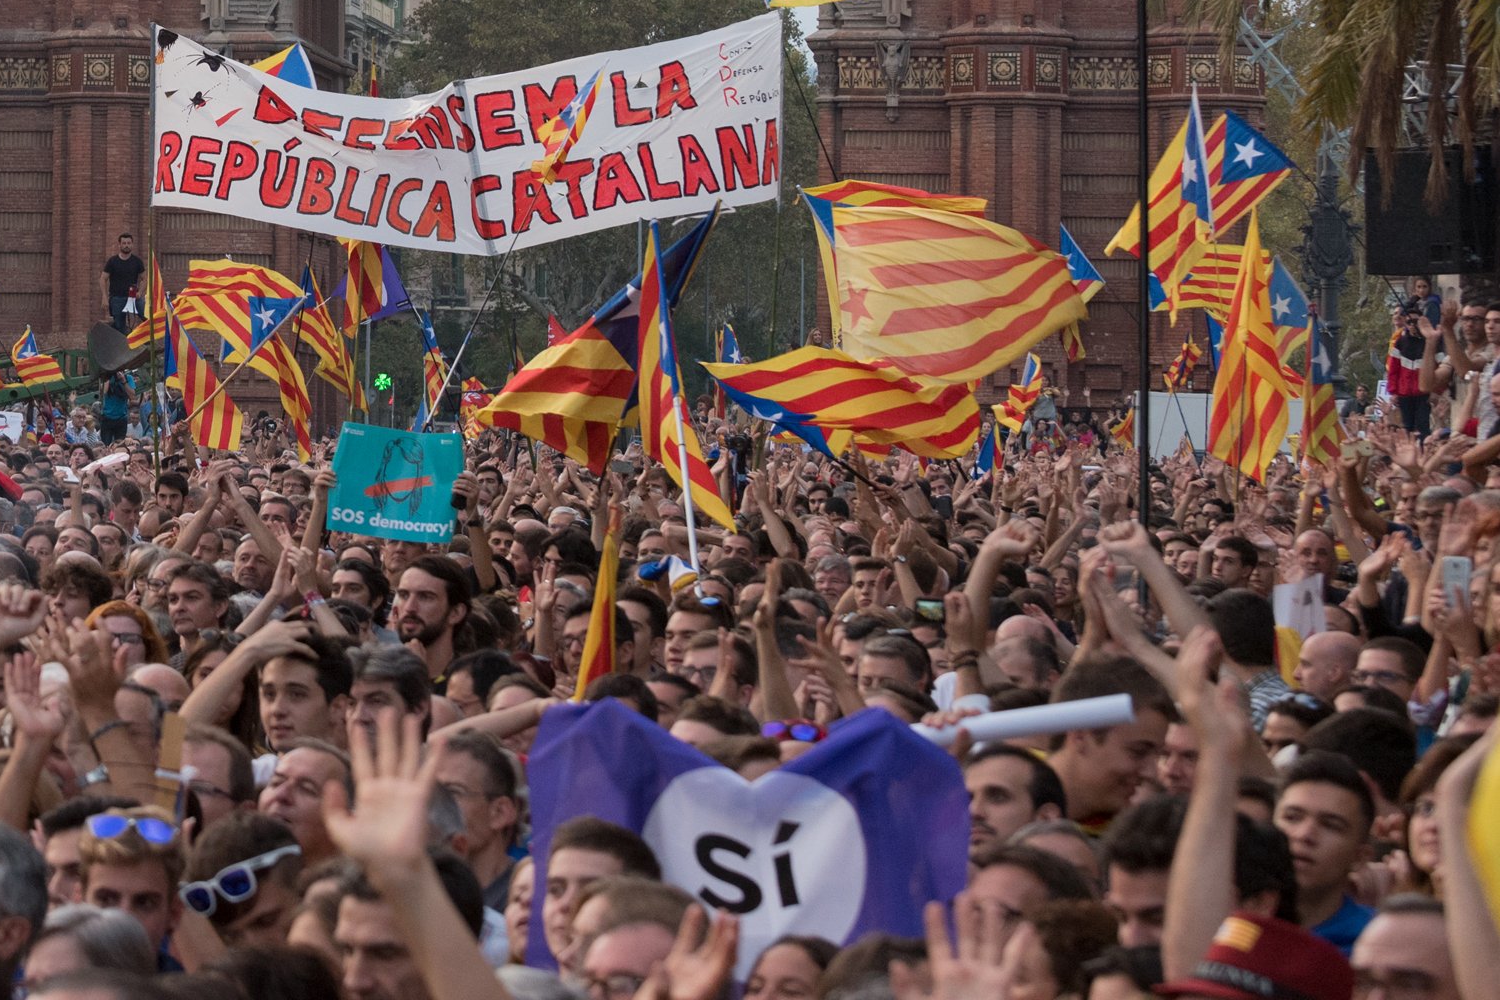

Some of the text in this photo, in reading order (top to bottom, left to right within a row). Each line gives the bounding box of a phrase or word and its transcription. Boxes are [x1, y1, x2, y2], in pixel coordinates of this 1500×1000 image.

[610, 60, 698, 128] LA
[154, 117, 779, 242] REPÚBLICA CATALANA
[331, 506, 453, 537] SOS democracy!
[694, 819, 802, 915] Sí
